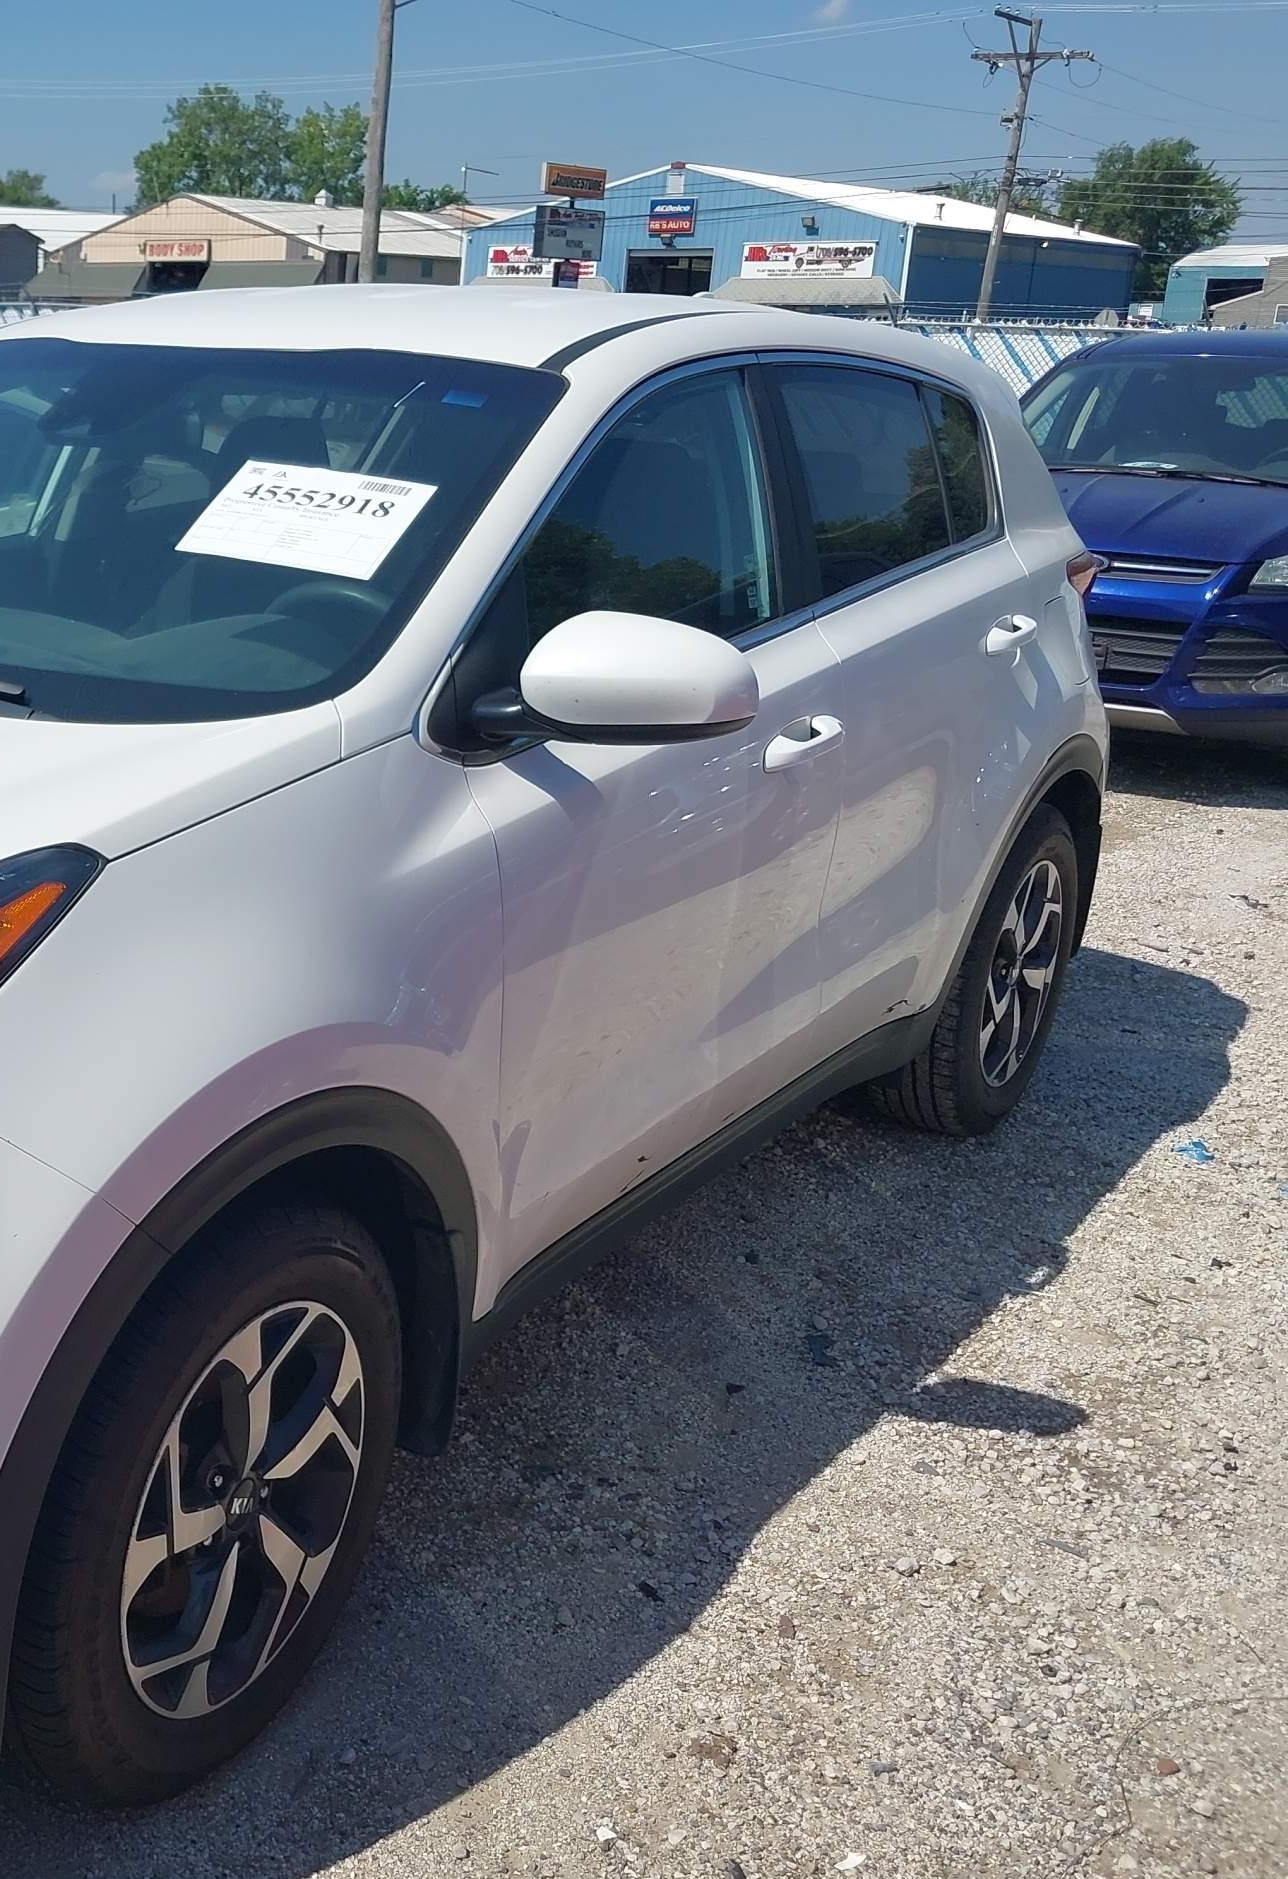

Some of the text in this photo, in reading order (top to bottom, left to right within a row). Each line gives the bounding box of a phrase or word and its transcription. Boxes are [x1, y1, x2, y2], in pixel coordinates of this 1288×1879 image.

[668, 220, 690, 229] AUTO
[148, 243, 204, 257] BODY SHOP
[242, 482, 396, 518] 45552918
[230, 1497, 254, 1514] KIA
